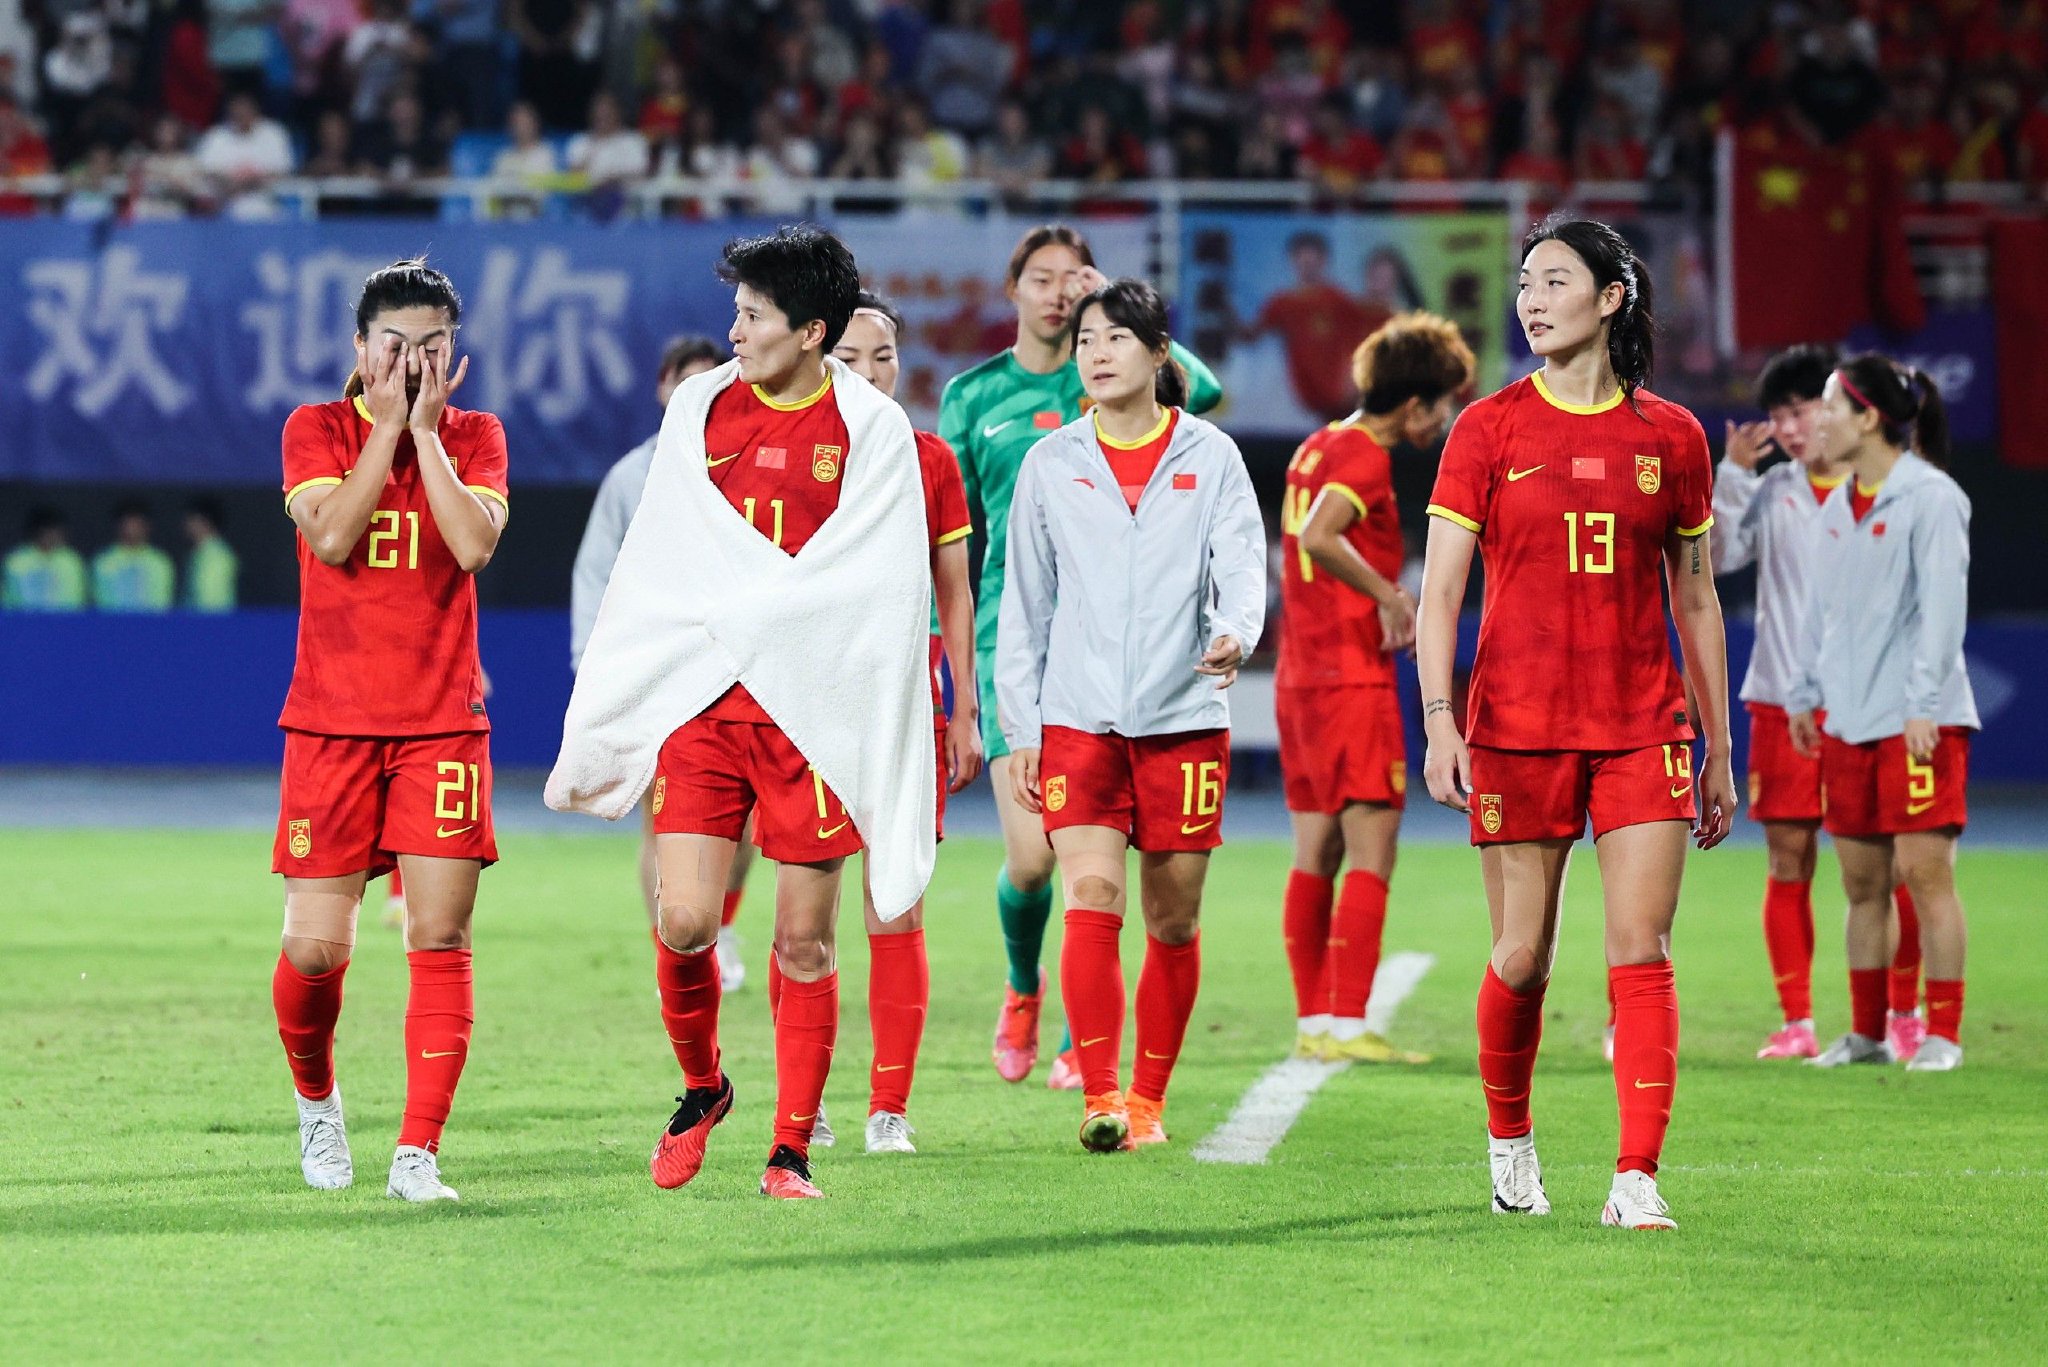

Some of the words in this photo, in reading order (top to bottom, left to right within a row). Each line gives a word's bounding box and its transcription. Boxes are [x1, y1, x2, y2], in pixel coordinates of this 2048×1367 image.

[368, 510, 419, 569] 21
[1563, 512, 1615, 574] 13
[434, 761, 479, 822] 21
[1180, 761, 1220, 816] 16
[1482, 797, 1500, 805] CFA
